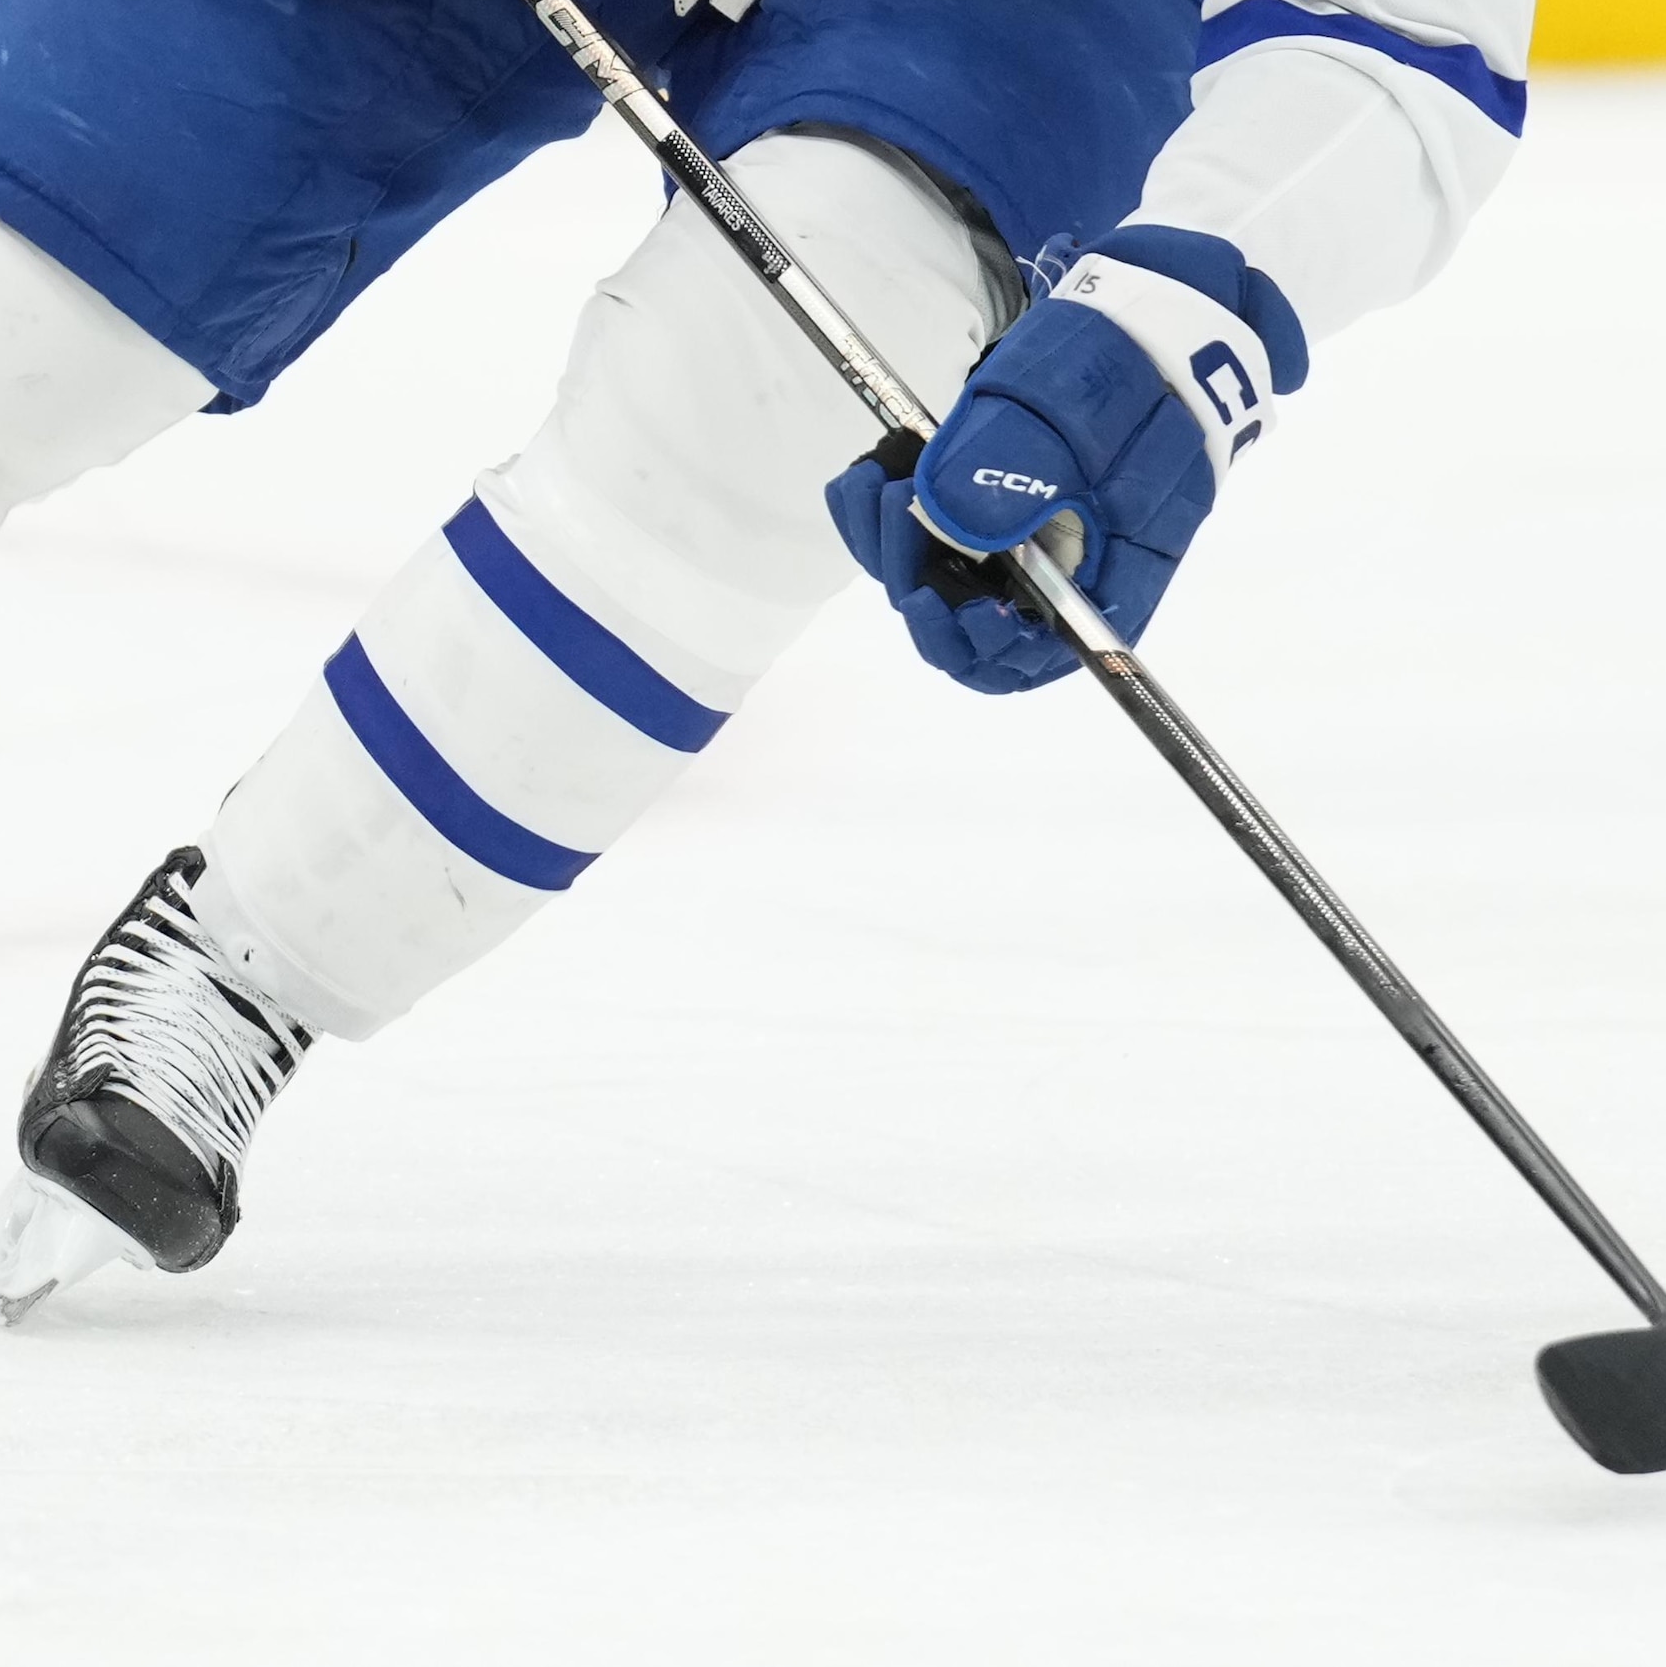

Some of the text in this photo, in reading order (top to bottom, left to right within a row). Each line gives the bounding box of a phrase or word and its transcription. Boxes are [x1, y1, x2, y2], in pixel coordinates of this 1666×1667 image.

[701, 183, 743, 231] TAVARES
[1073, 272, 1101, 294] 15
[972, 468, 1059, 500] CCM
